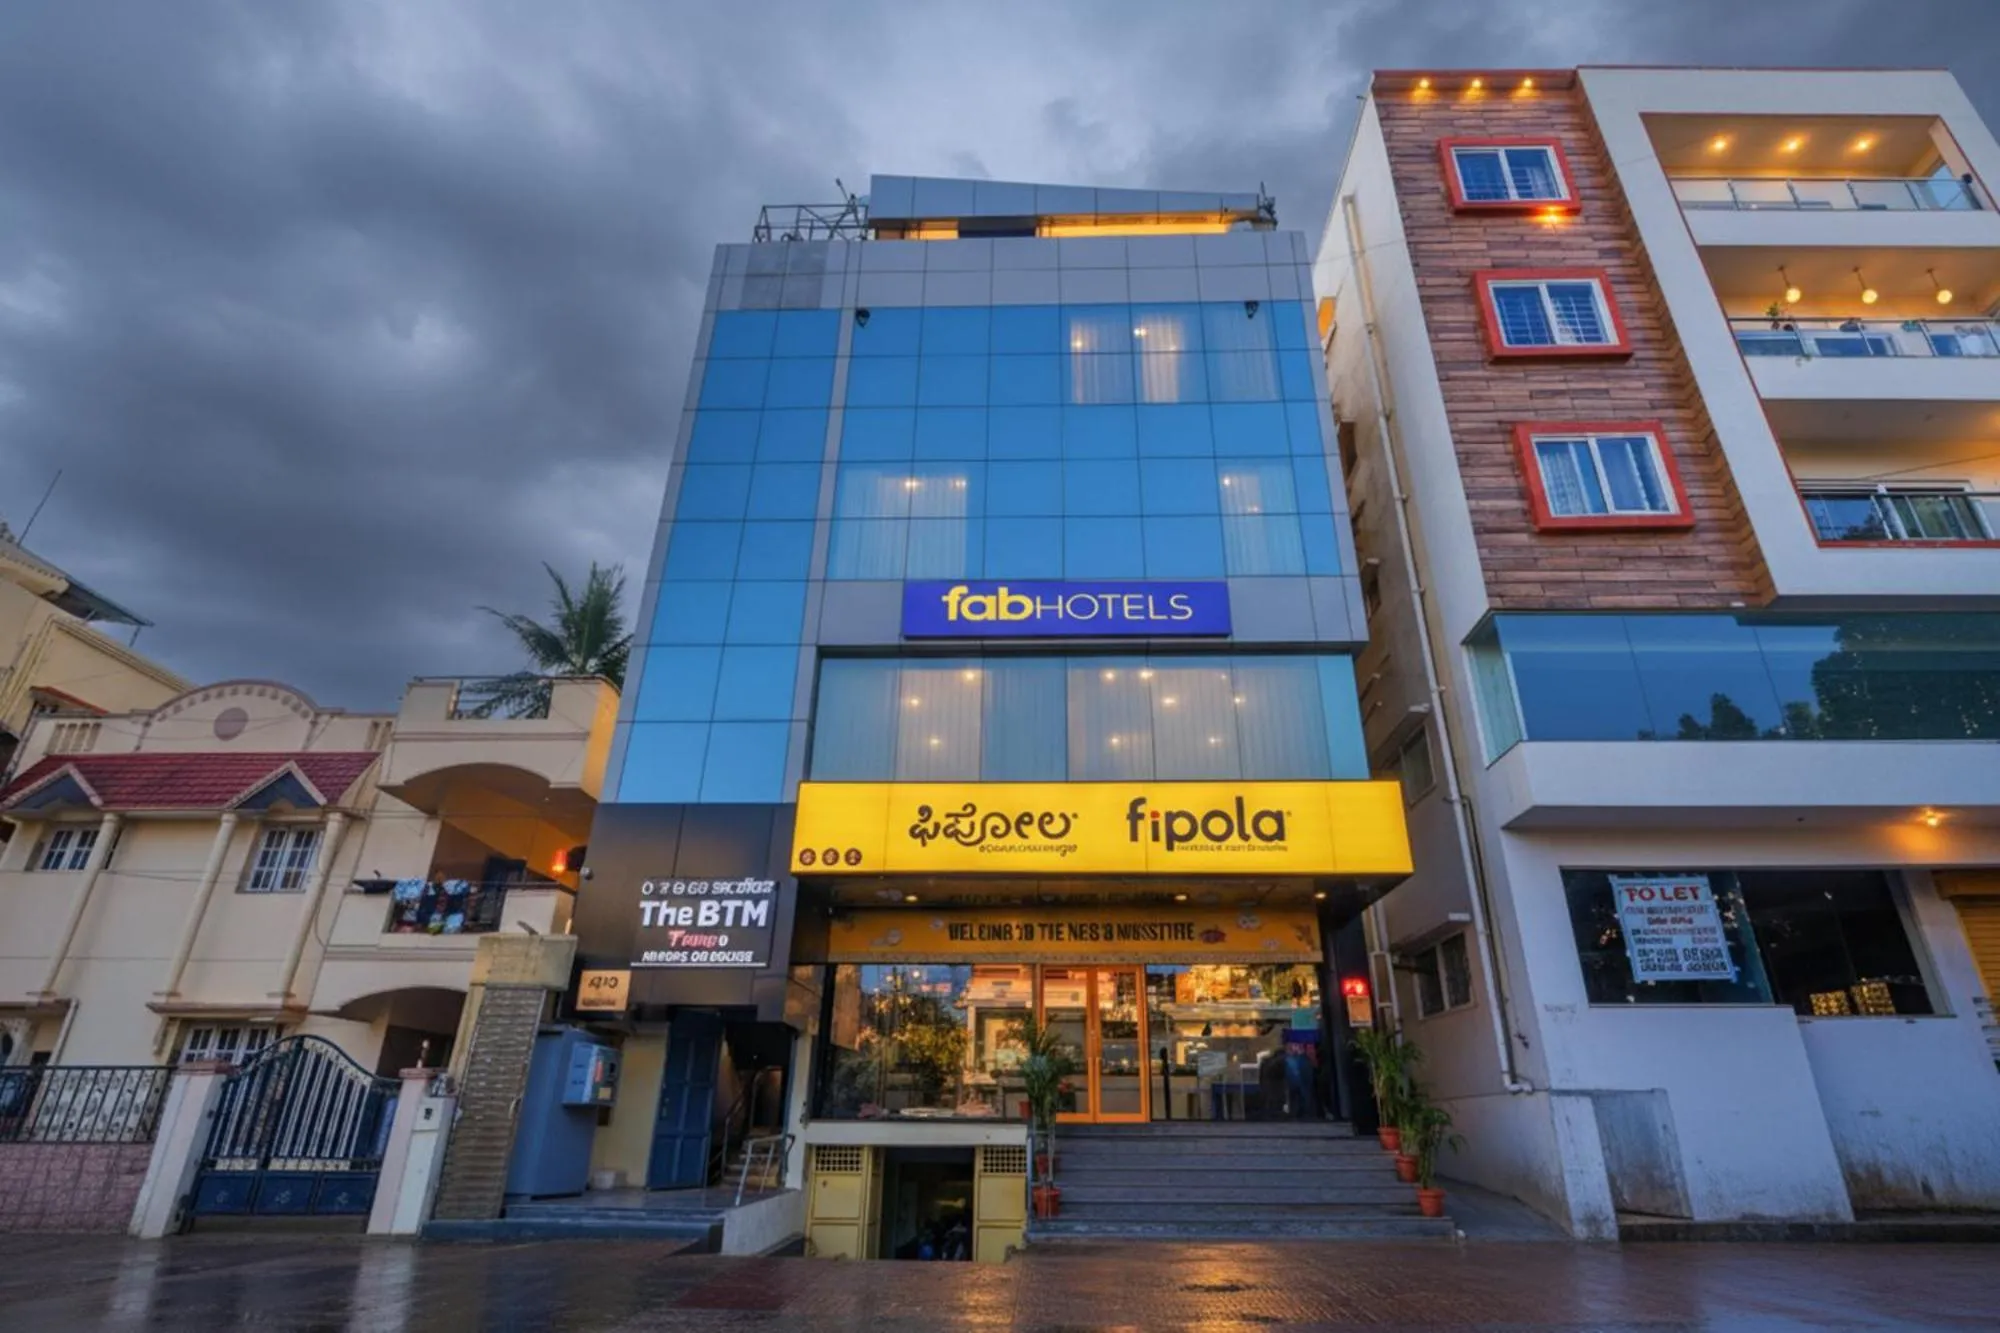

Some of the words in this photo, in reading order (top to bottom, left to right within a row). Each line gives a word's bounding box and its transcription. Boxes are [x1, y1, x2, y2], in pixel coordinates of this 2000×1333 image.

[942, 586, 1193, 621] fabHOTELS
[1126, 796, 1285, 852] fipola
[1624, 886, 1657, 902] TO
[1660, 886, 1701, 902] LET
[639, 900, 693, 927] The
[697, 900, 769, 927] BTM
